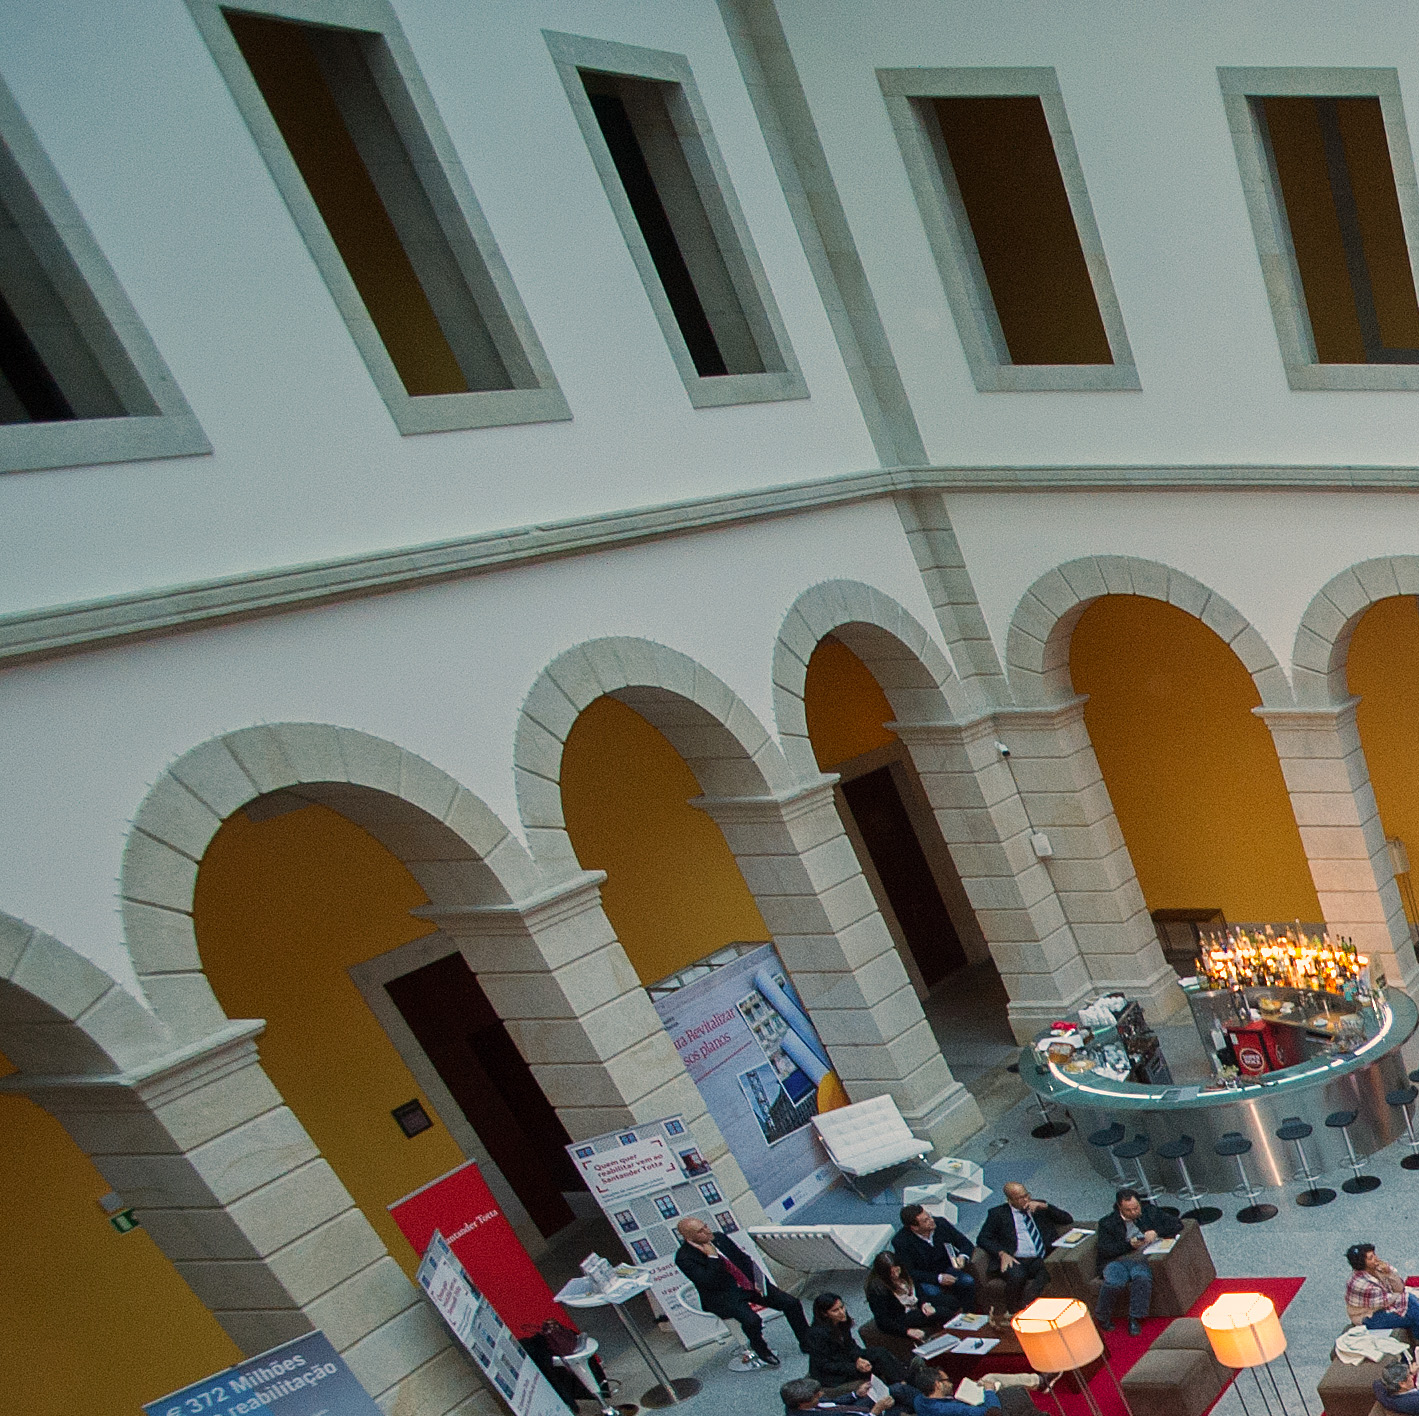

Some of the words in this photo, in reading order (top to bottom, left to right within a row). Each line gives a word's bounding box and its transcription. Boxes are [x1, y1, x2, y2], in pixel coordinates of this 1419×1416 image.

[685, 1007, 736, 1043] Revitalizar
[700, 1032, 732, 1059] planos
[594, 1159, 619, 1171] Quem
[619, 1154, 637, 1164] quer
[598, 1162, 635, 1177] reabilitar
[637, 1156, 653, 1165] vem
[601, 1168, 641, 1184] Santander
[642, 1161, 664, 1171] Totta
[447, 1221, 478, 1245] antander
[475, 1209, 499, 1224] Totta
[185, 1386, 230, 1414] 372
[229, 1354, 307, 1394] Milhões
[228, 1362, 338, 1416] reabilitação
